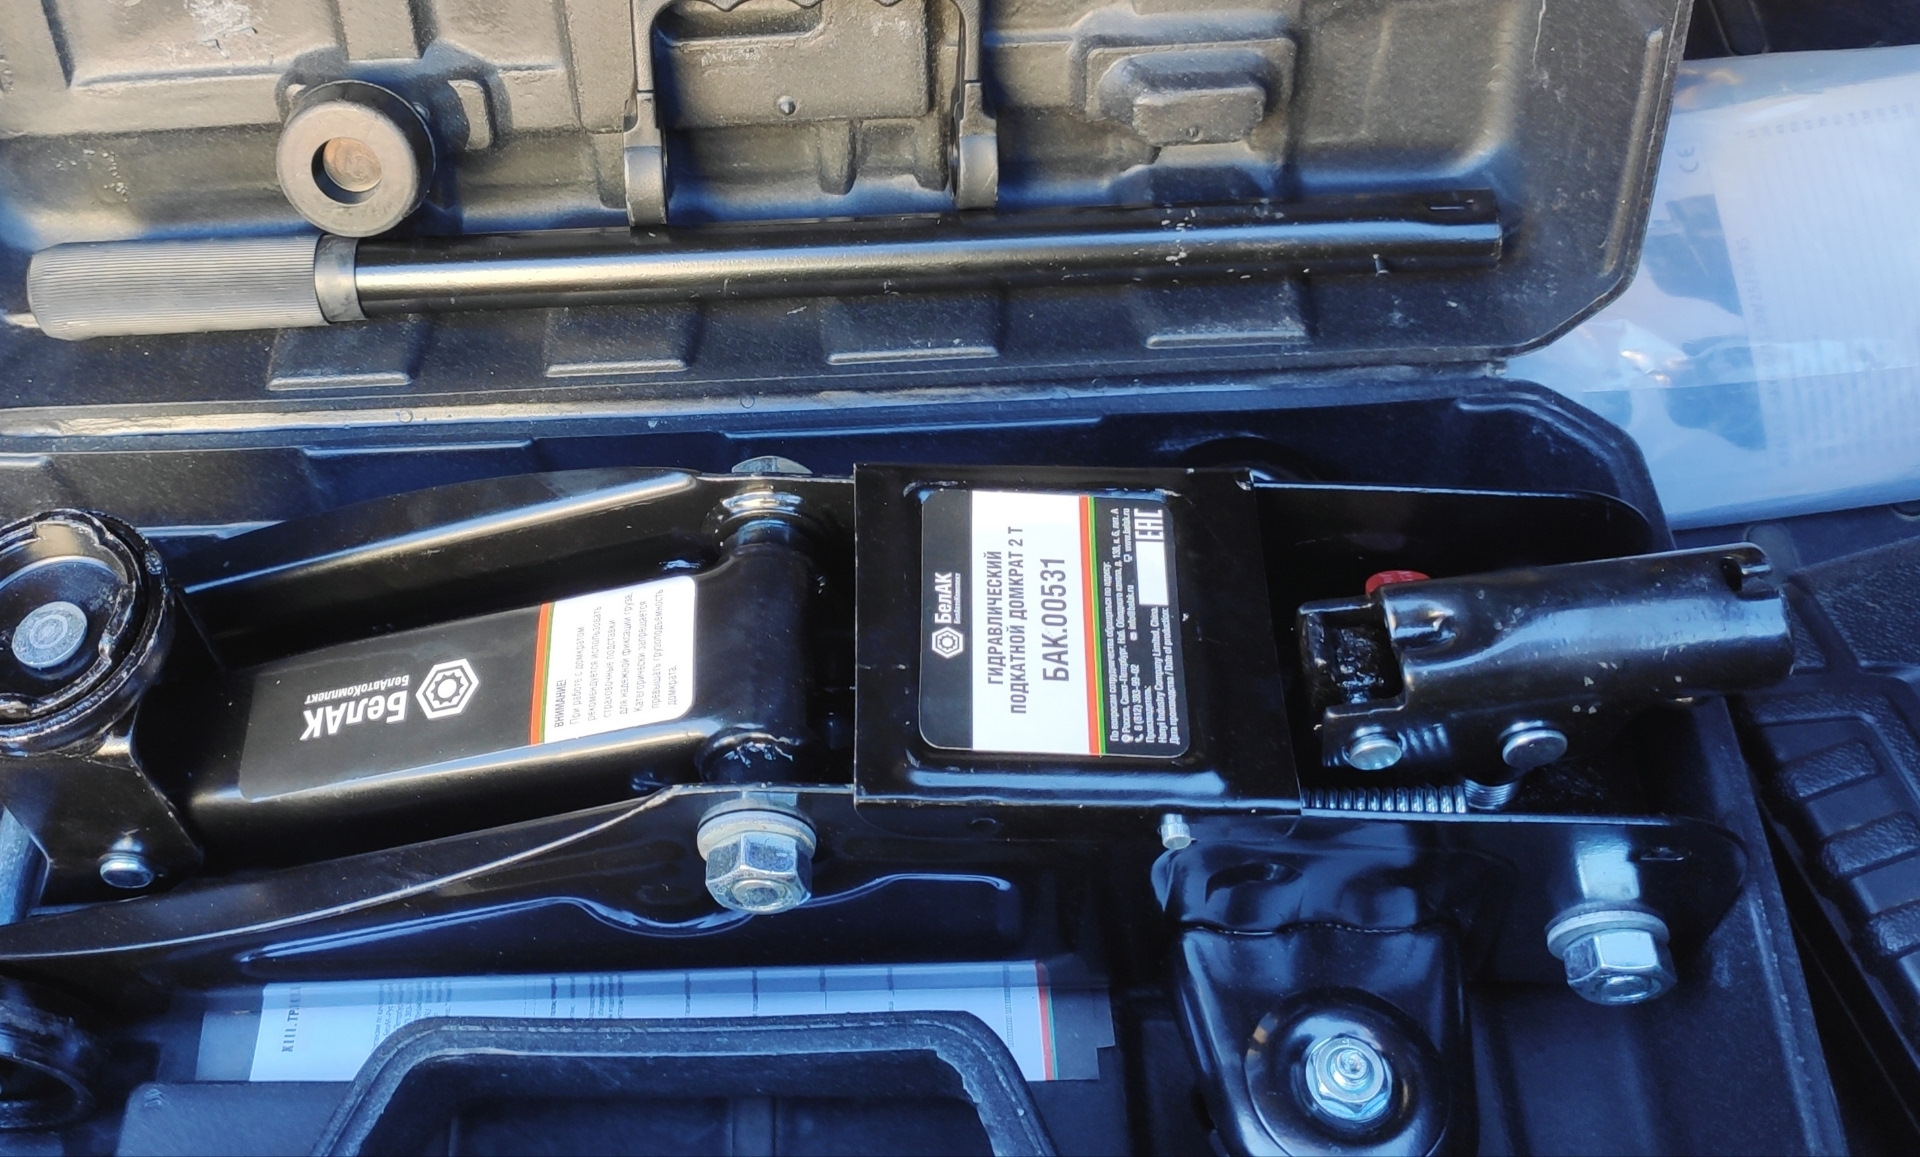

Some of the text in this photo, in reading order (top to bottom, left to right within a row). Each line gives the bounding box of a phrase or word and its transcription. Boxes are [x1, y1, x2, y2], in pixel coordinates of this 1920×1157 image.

[934, 572, 953, 623] БелАК
[984, 551, 1006, 685] ГИДРАВЛИЧЕСКИЙ
[1007, 526, 1028, 714] ПОДКАТНОЙ ДОМКРАТ 2 Т
[1040, 558, 1069, 682] БАК.00531
[575, 627, 586, 669] домкратом
[621, 617, 633, 655] фиксации
[634, 600, 648, 711] Категорически запрещается
[587, 606, 601, 721] рекомендуется использовать
[603, 620, 616, 717] страховочные подставки
[651, 663, 662, 708] превышать
[304, 674, 409, 705] БелАвтоКомплект
[554, 679, 567, 728] ВНИМАНИЕ!
[572, 679, 583, 705] работе
[619, 700, 628, 714] для
[298, 691, 408, 741] БелАК
[570, 708, 580, 724] При
[1133, 705, 1144, 724] (812)
